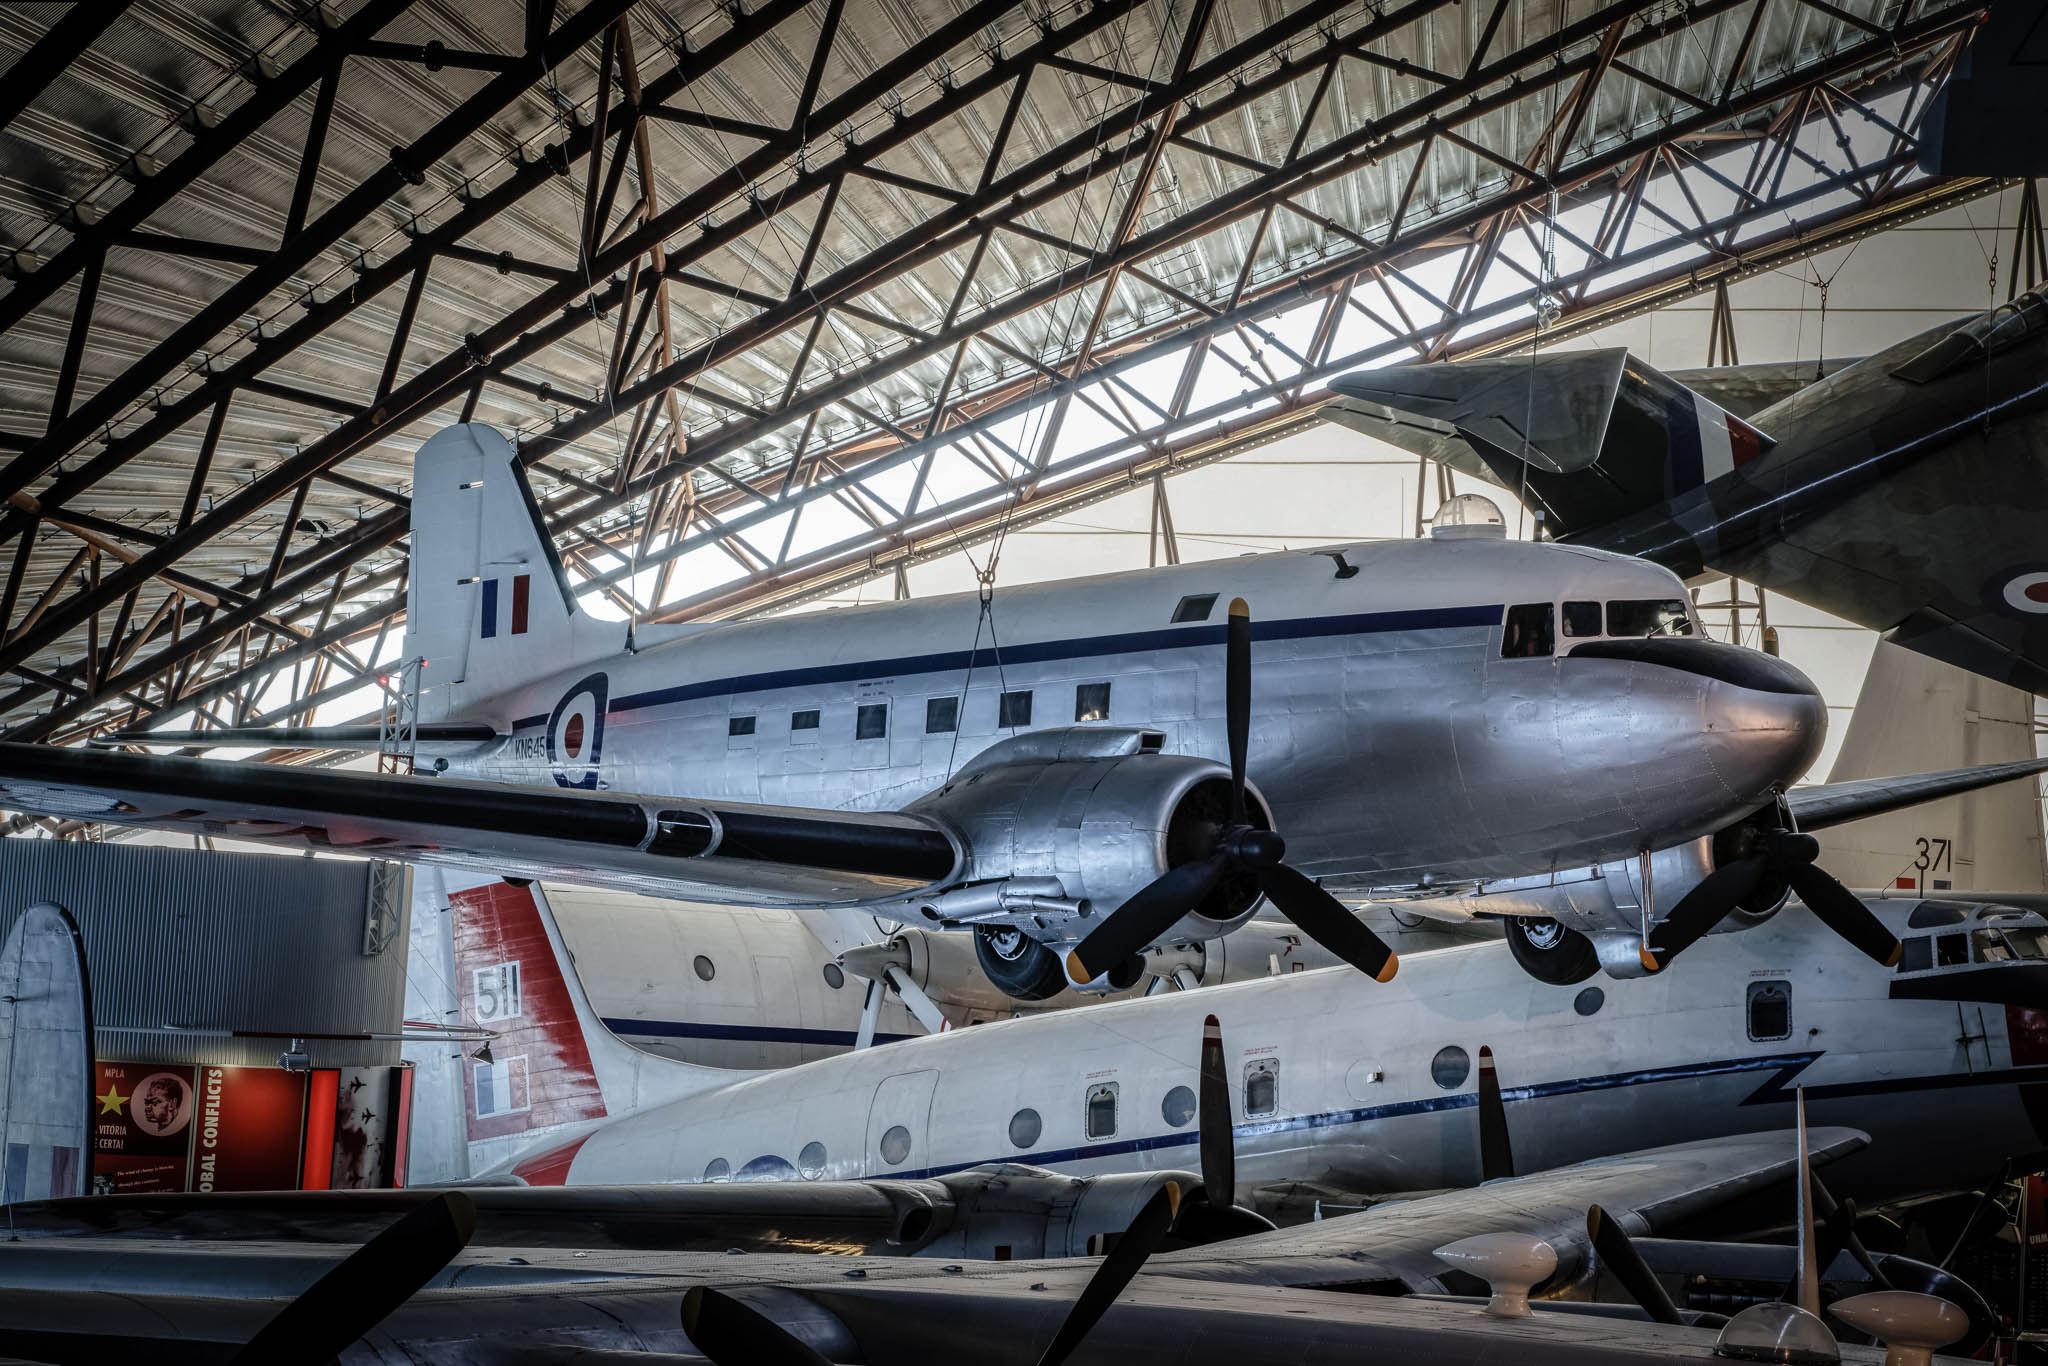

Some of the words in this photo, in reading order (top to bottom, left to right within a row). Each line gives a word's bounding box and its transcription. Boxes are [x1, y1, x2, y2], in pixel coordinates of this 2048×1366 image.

[515, 736, 545, 760] KN645
[1914, 837, 1951, 872] 371
[477, 965, 518, 1019] 511
[104, 1068, 125, 1078] MPLA
[202, 1069, 223, 1148] CONFLICTS
